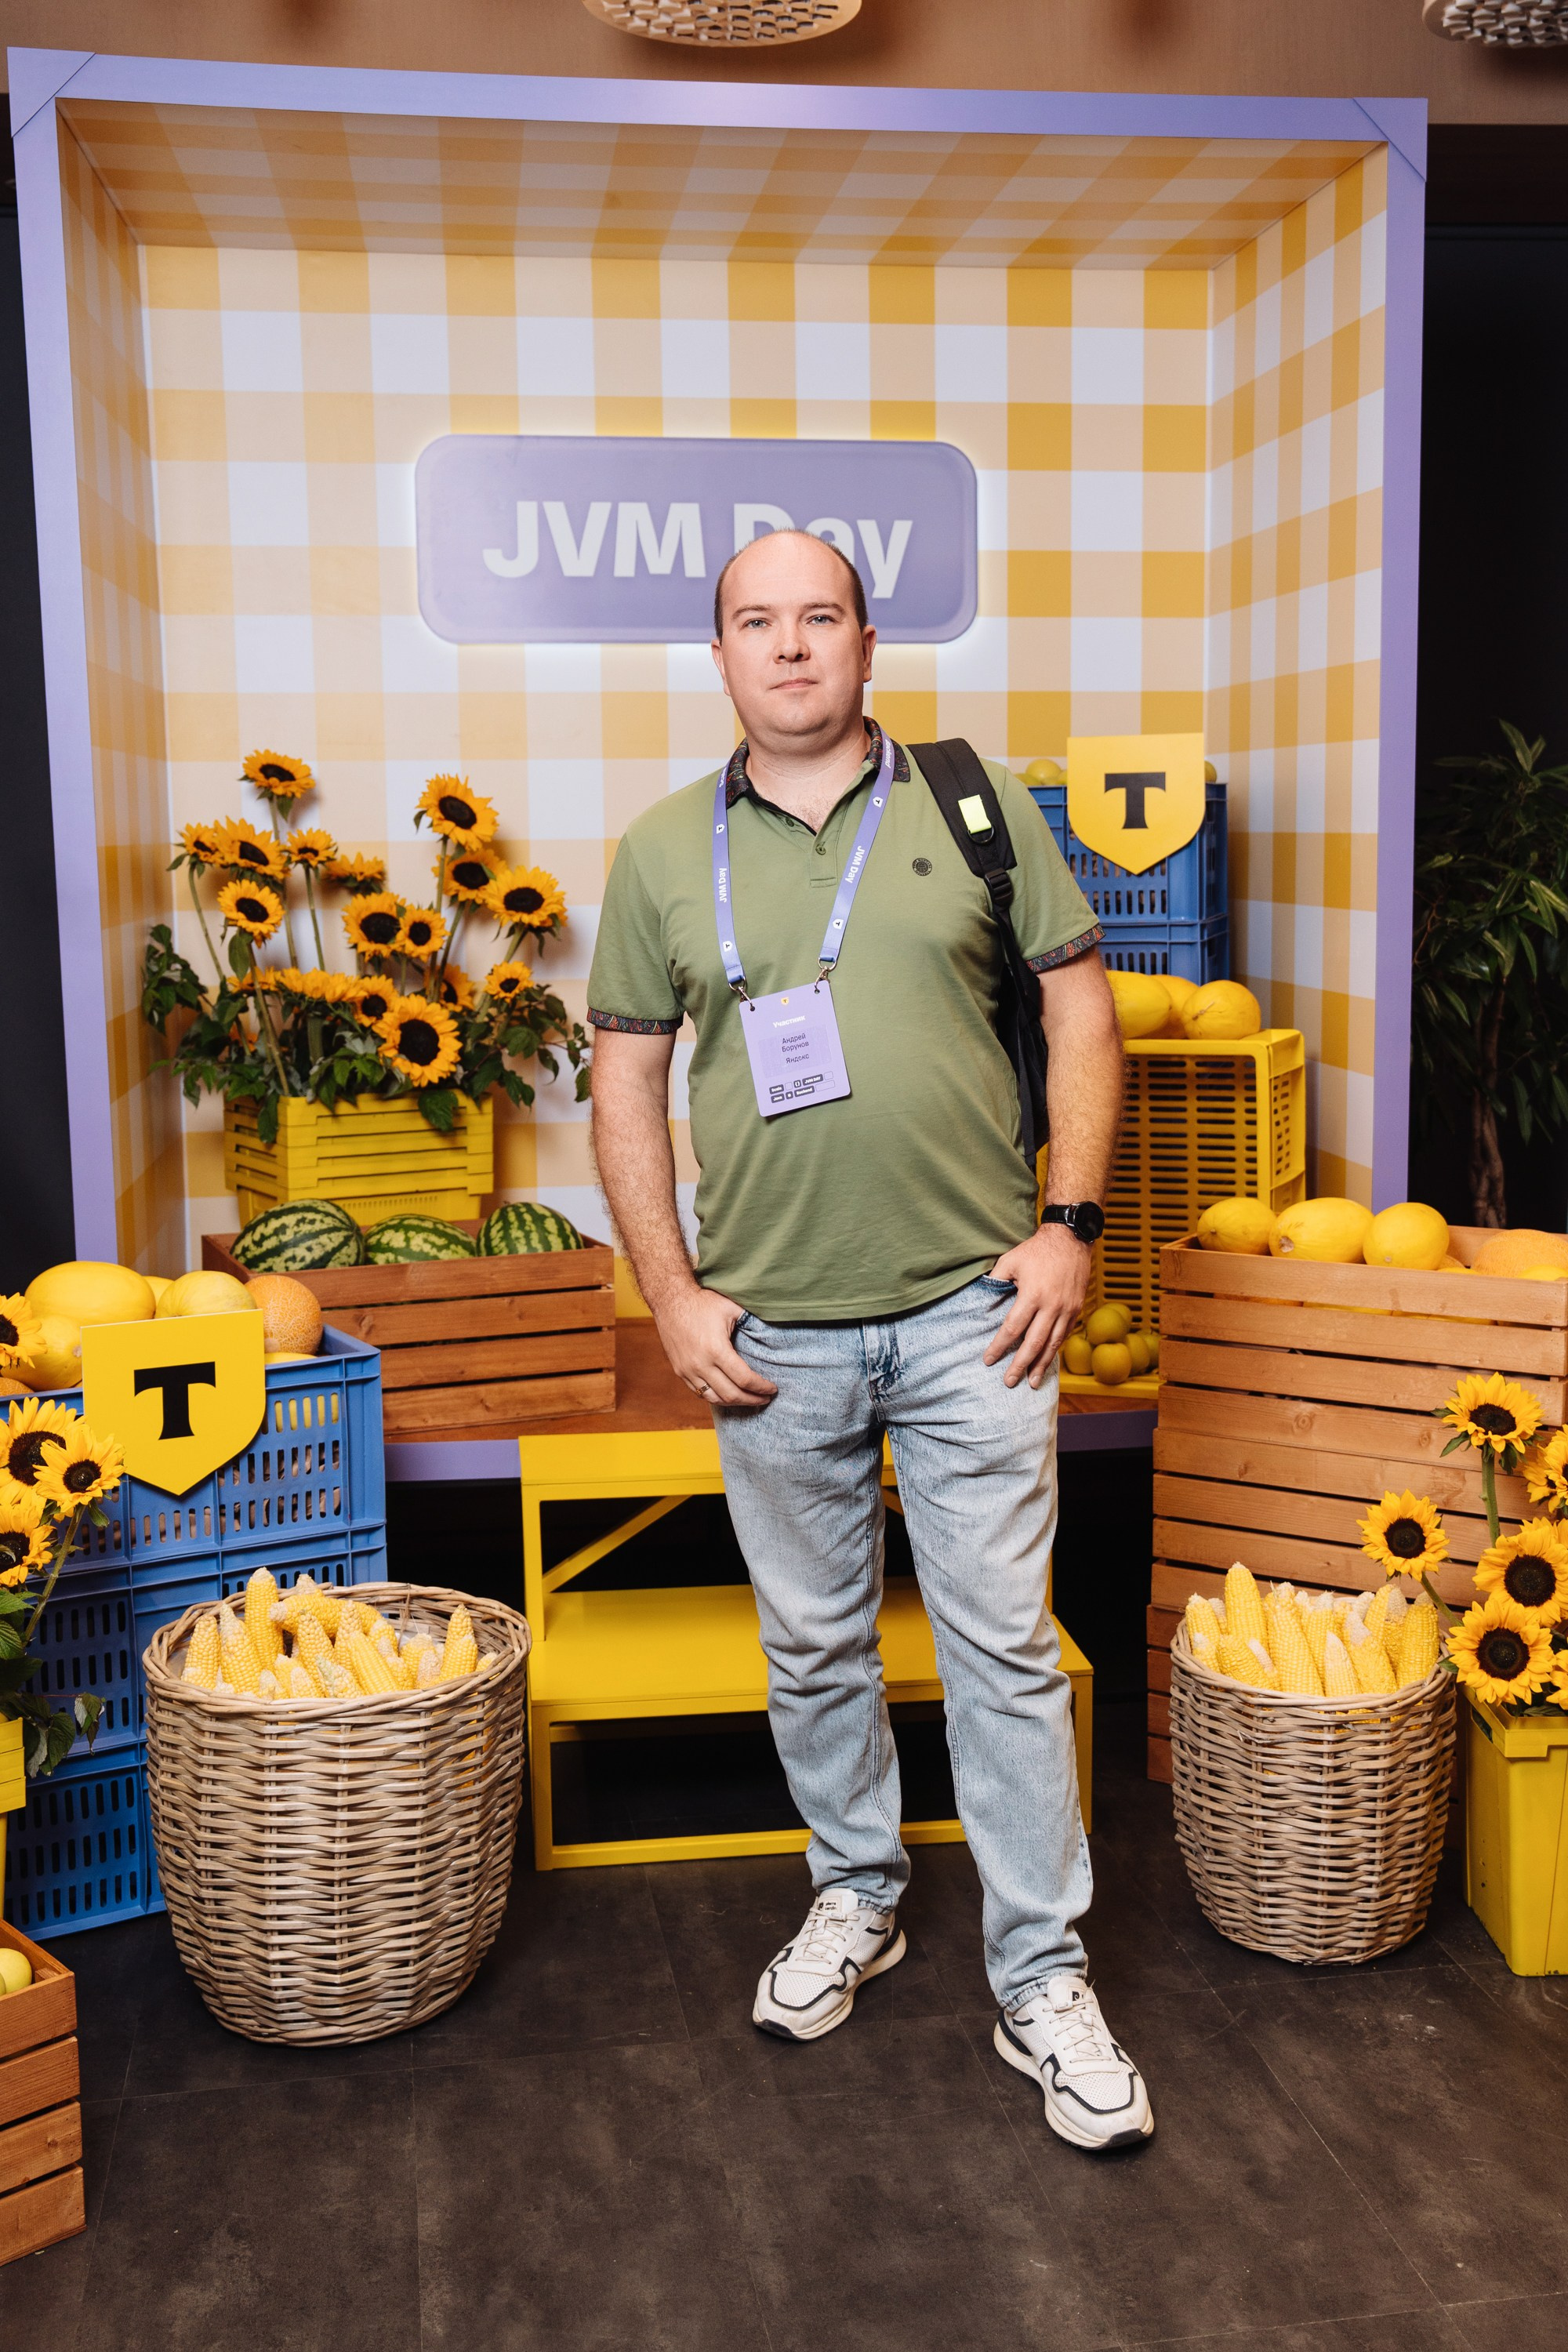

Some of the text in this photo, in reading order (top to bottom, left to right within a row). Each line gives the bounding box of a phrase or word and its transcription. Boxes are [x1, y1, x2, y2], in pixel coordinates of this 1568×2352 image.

[482, 500, 706, 579] JVM
[1104, 771, 1166, 829] T
[844, 846, 865, 884] JVM Day
[718, 867, 728, 903] JVM Day
[772, 1015, 806, 1029] Участник
[782, 1033, 806, 1044] Андрей
[782, 1041, 809, 1052] Борунов
[786, 1054, 810, 1064] Яндекс
[133, 1361, 216, 1440] T
